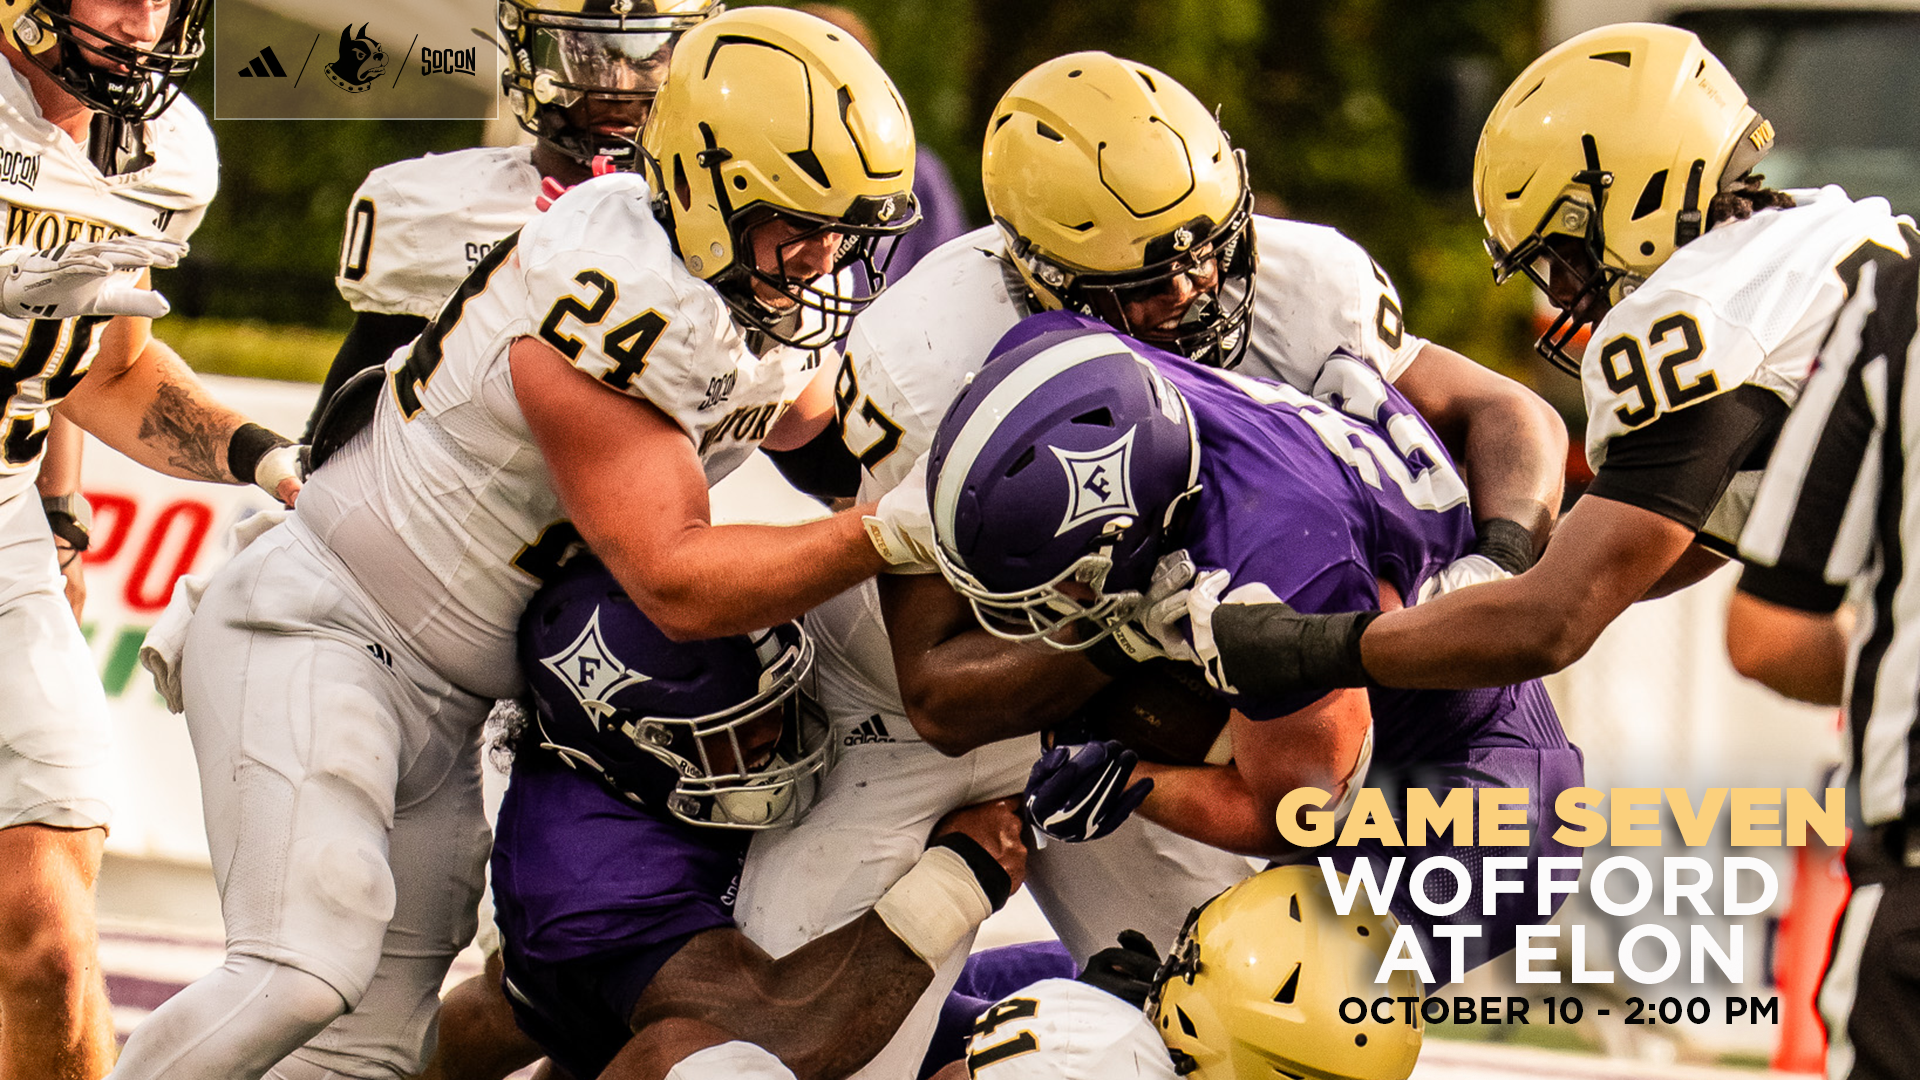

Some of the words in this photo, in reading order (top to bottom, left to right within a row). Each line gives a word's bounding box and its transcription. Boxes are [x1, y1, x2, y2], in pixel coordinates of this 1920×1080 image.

[538, 267, 672, 393] 24
[1598, 310, 1721, 430] 92
[1082, 464, 1112, 504] F
[577, 655, 601, 688] F
[965, 996, 1041, 1080] 41
